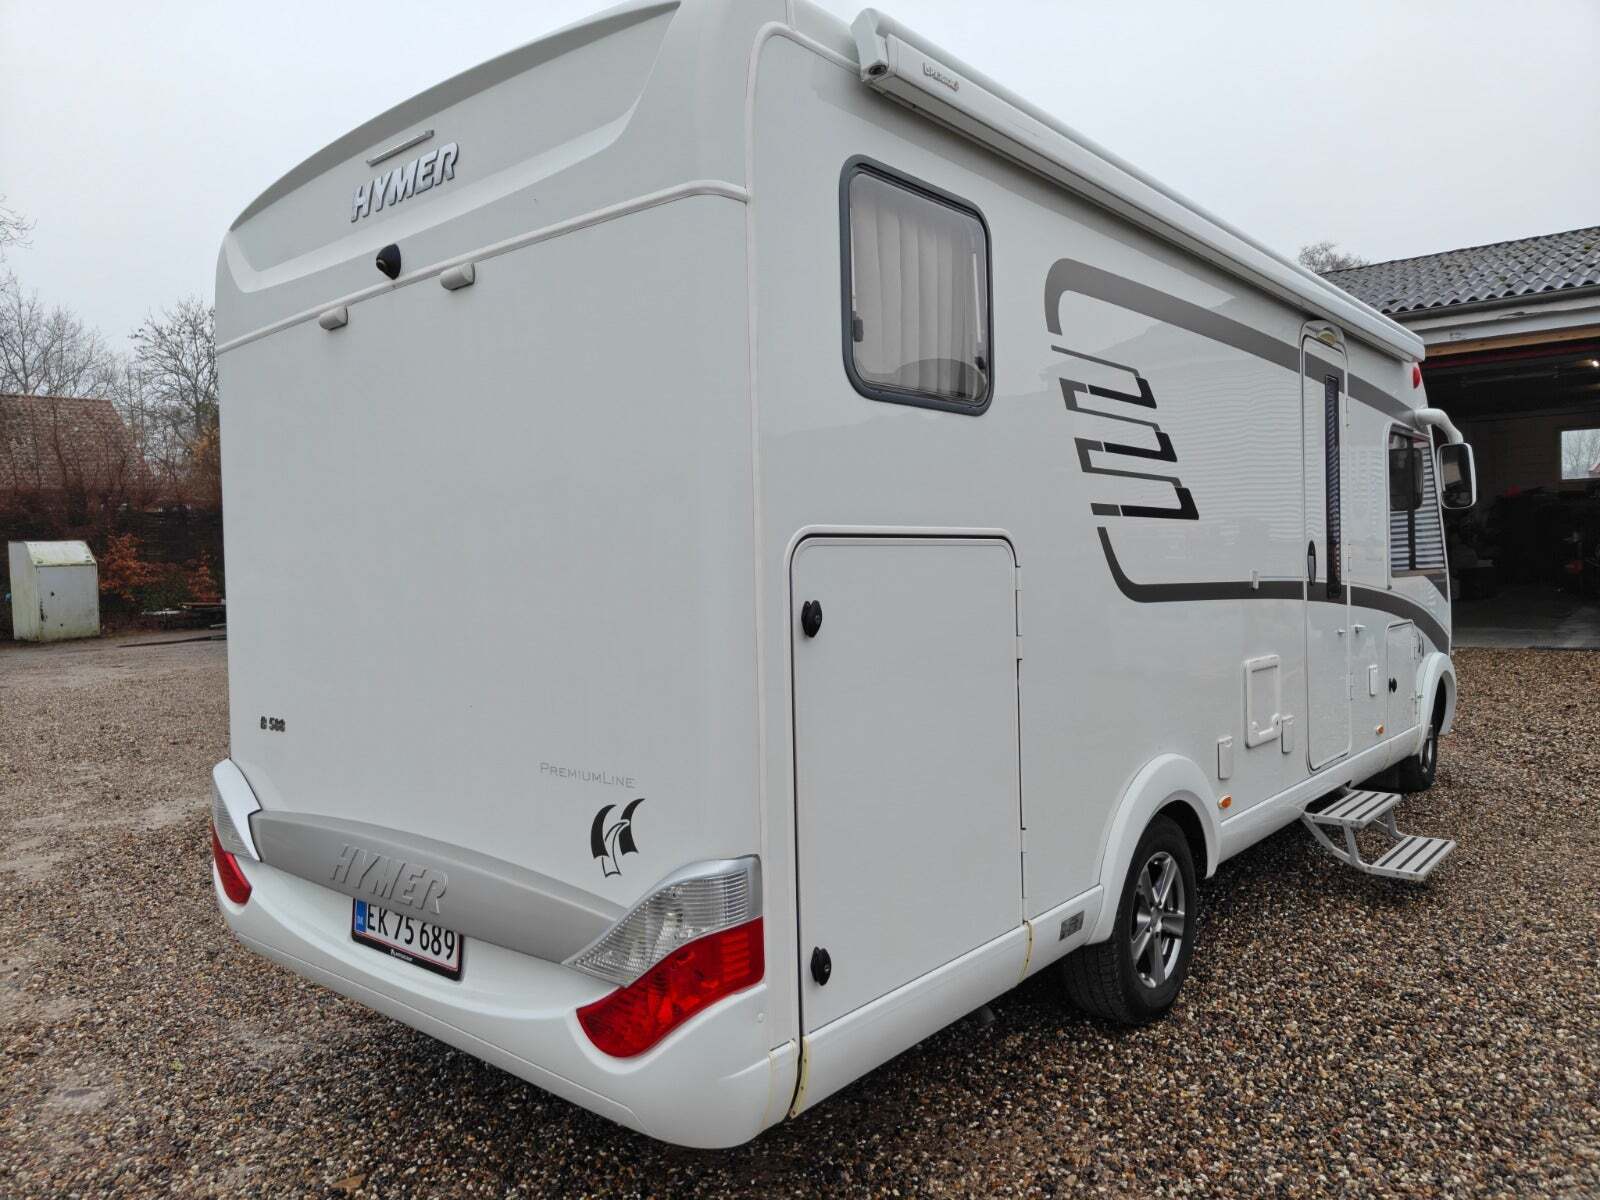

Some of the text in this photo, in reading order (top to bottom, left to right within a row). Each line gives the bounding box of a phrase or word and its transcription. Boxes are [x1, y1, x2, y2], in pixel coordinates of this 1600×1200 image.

[350, 141, 459, 223] HYMER
[330, 843, 449, 915] HYMER
[367, 903, 389, 937] EK
[393, 912, 415, 945] 75
[419, 922, 456, 960] 689
